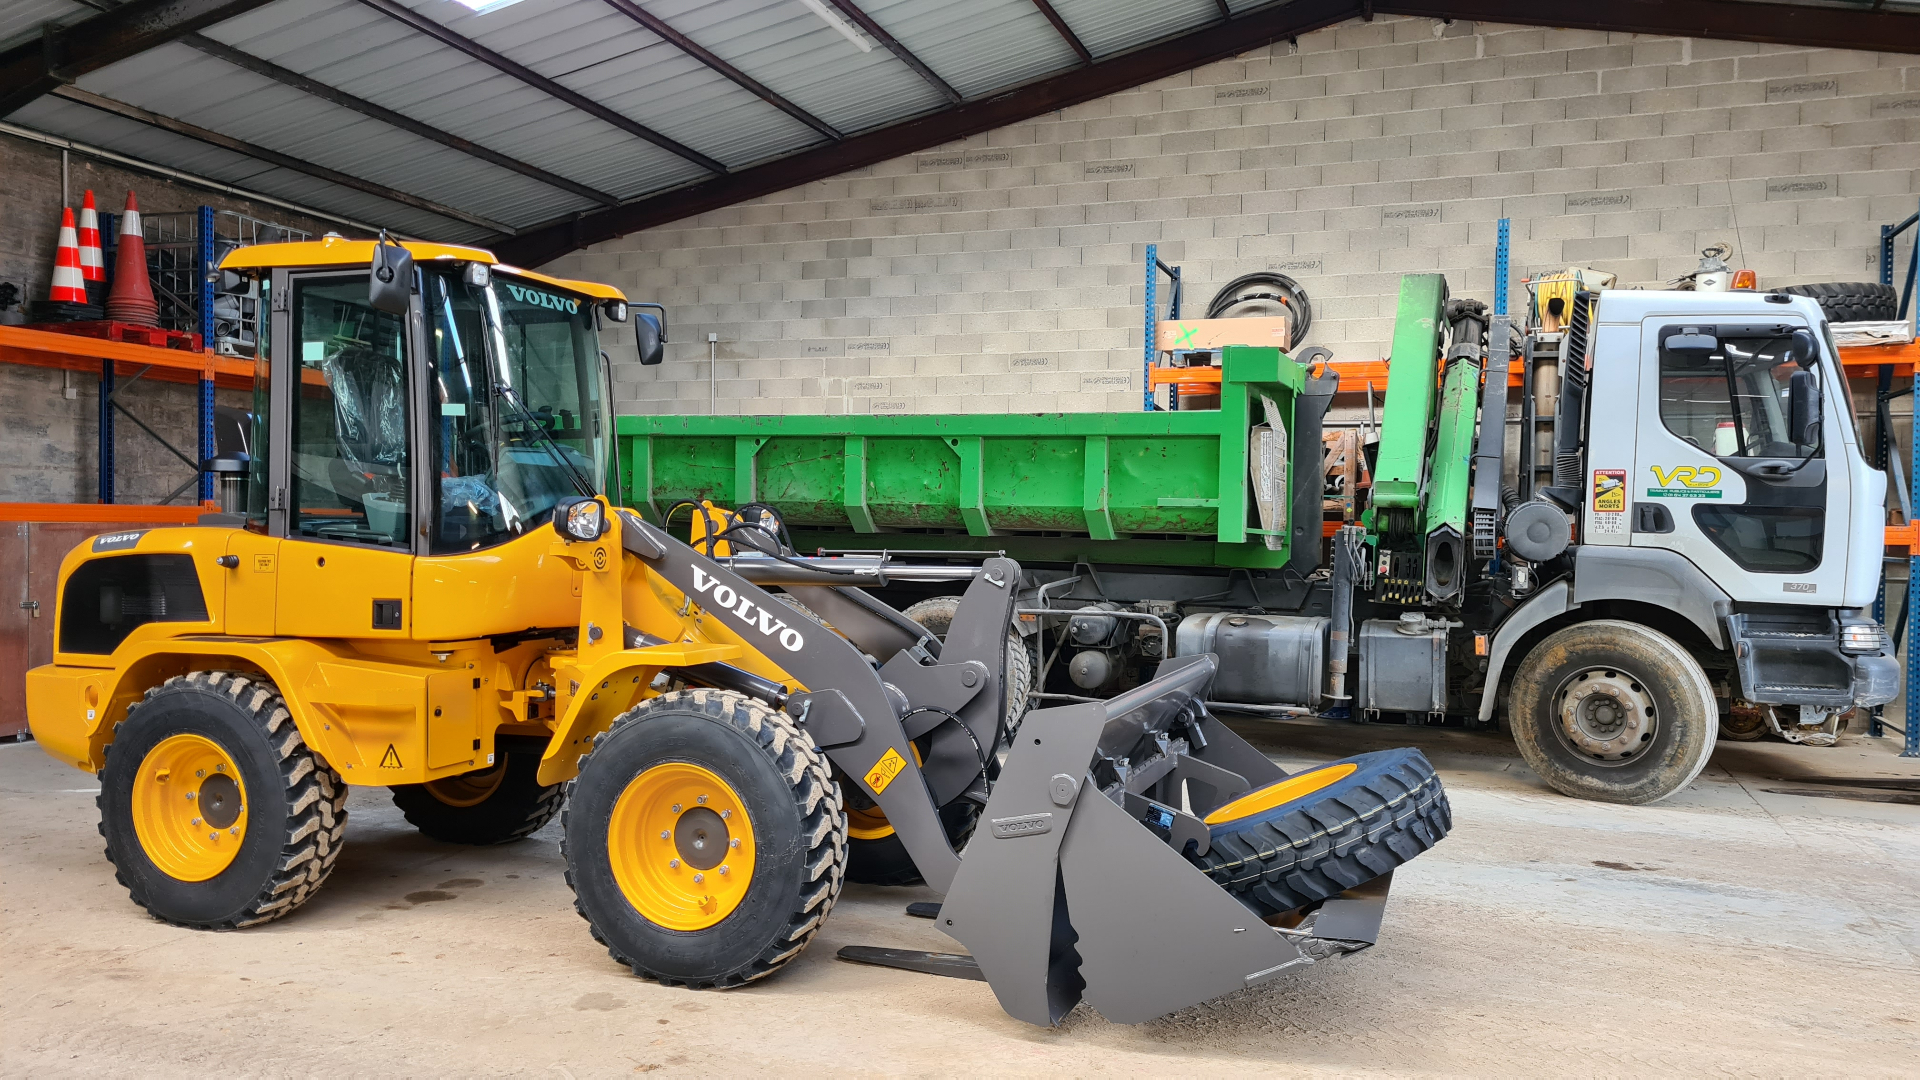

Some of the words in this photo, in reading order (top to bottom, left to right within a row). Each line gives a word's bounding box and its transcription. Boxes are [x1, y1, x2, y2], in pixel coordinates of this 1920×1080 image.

[505, 283, 578, 315] VOLVO
[1650, 466, 1722, 488] VRD
[99, 533, 140, 545] VOLVO
[1790, 583, 1810, 591] 370
[690, 563, 804, 652] VOLVO
[997, 819, 1045, 833] VOLVO
